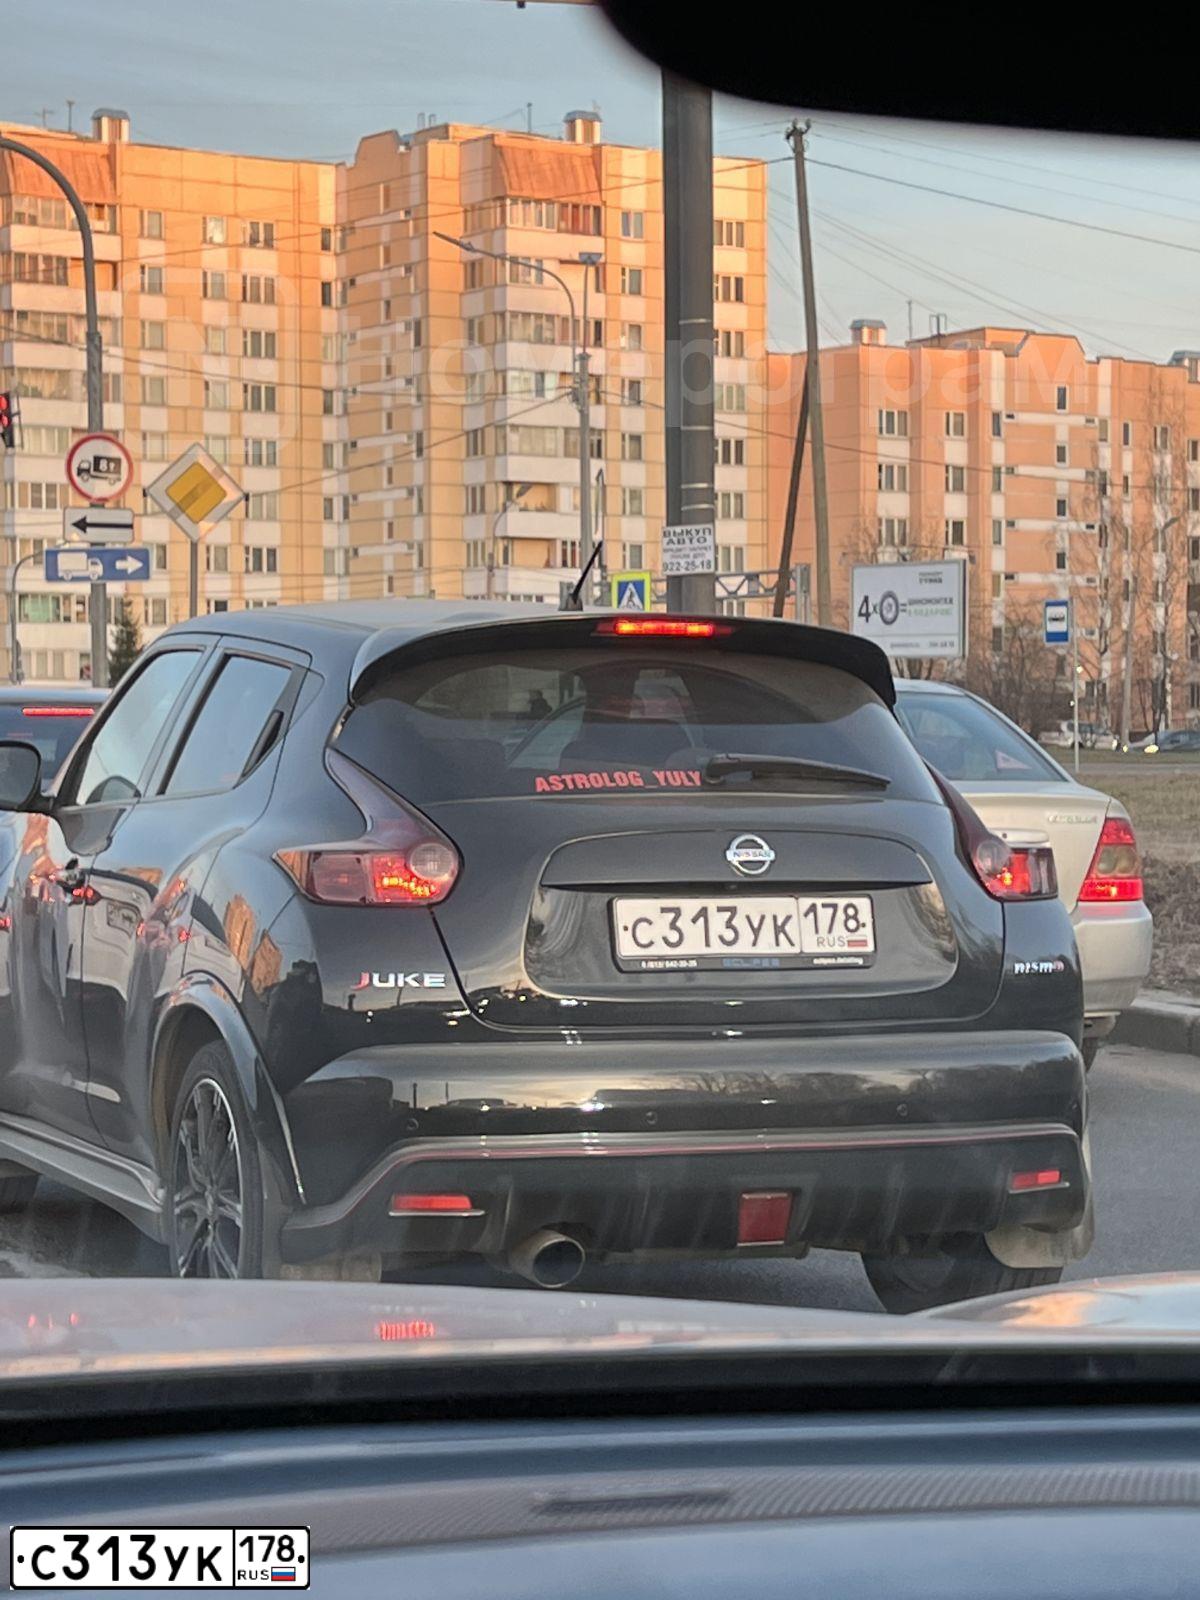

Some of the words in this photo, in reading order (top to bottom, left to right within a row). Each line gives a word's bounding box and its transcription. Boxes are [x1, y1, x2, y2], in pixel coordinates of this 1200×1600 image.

[663, 527, 712, 538] ВЫКУП
[666, 536, 708, 546] АВТО
[534, 770, 702, 793] ASTROLOG_YULY
[803, 902, 861, 935] 178
[816, 935, 846, 948] RUS
[350, 972, 446, 991] JUKE
